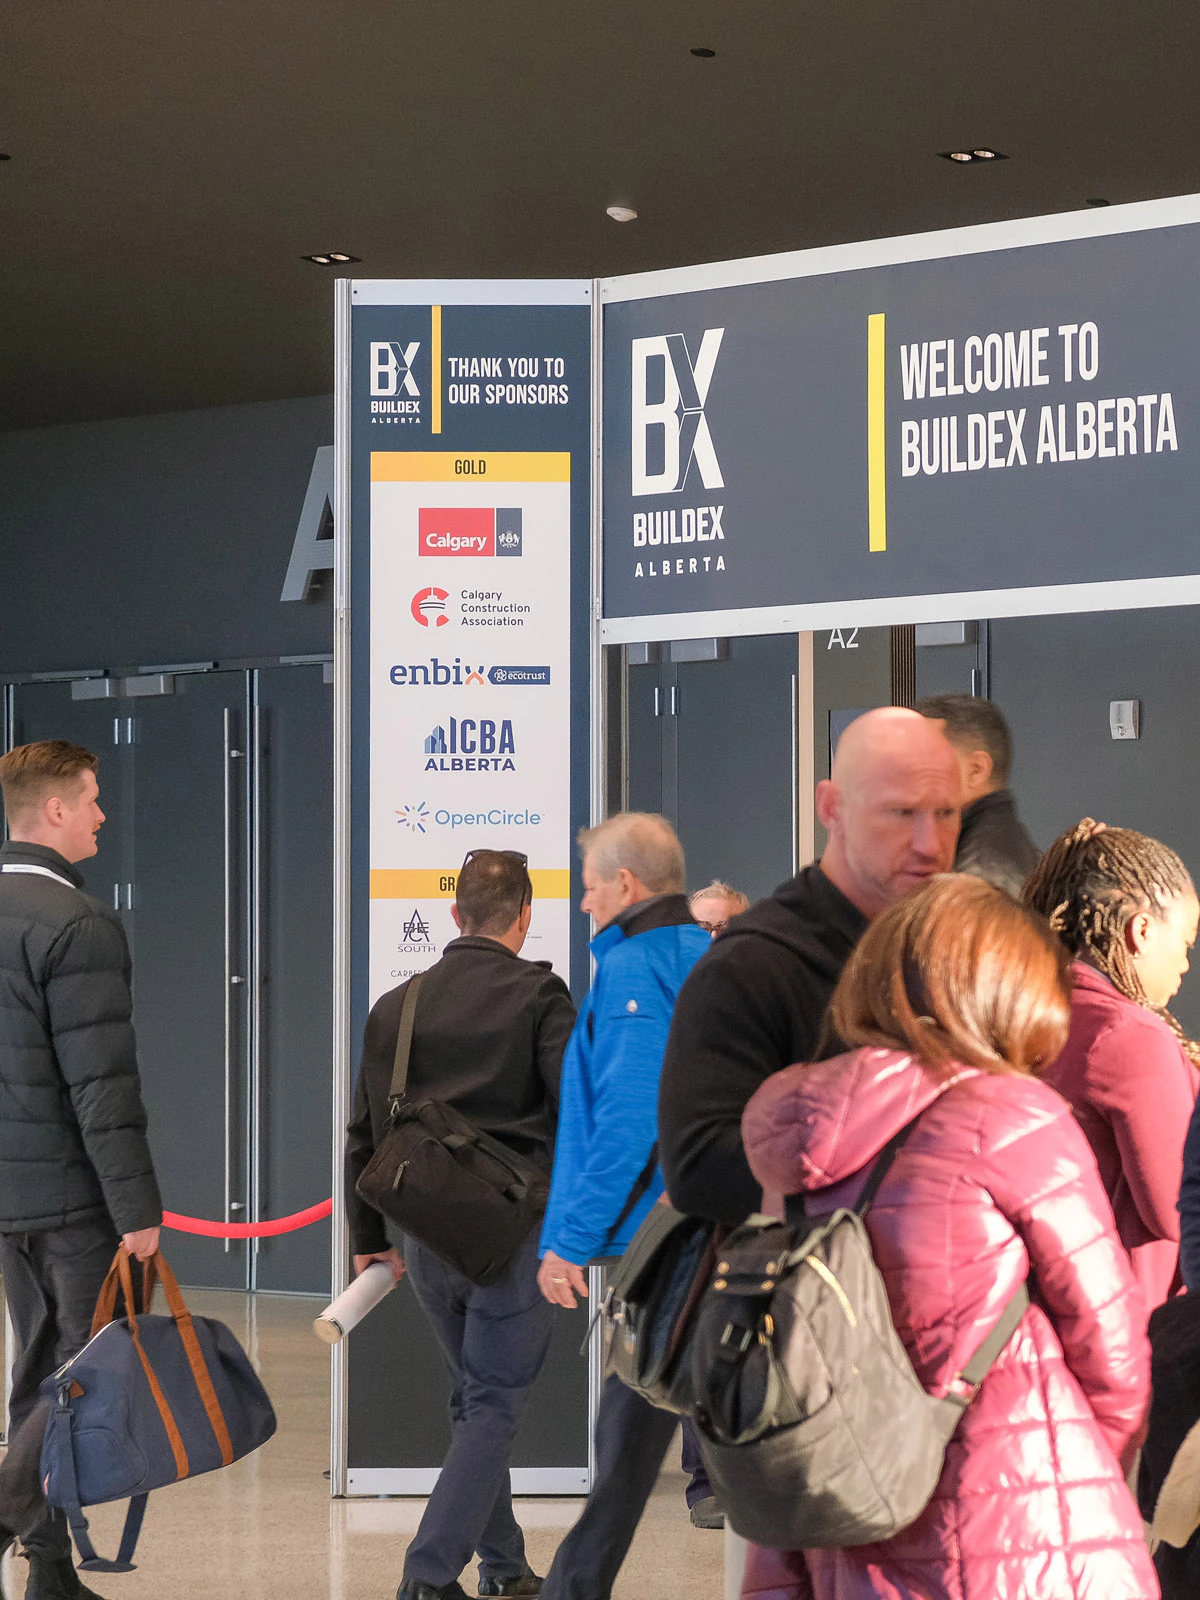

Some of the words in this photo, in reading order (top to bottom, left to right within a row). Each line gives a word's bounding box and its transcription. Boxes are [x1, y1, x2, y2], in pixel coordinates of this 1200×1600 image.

[370, 342, 421, 397] BX
[447, 357, 502, 378] THANK
[507, 357, 538, 378] YOU
[544, 357, 565, 378] TO
[900, 327, 1049, 401] WELCOME
[1058, 321, 1099, 383] TO
[448, 383, 480, 405] OUR
[485, 383, 569, 405] SPONSORS
[370, 400, 420, 414] BUILDEX
[631, 327, 725, 496] BX
[901, 408, 1027, 477] BUILDEX
[1036, 392, 1178, 464] ALBERTA
[454, 459, 486, 475] GOLD
[633, 505, 725, 547] BUILDEX
[425, 532, 487, 551] Calgary
[634, 555, 726, 578] ALBERTA
[461, 589, 502, 602] Calgary
[461, 603, 530, 613] Construction
[461, 616, 524, 626] Association
[827, 626, 859, 650] A2
[389, 658, 485, 685] enbix
[507, 671, 546, 680] ecotrust
[450, 716, 516, 754] ICBA
[424, 758, 516, 771] ALBERTA
[435, 809, 541, 829] OpenCircle
[439, 876, 456, 892] GR
[397, 945, 436, 953] SOUTH
